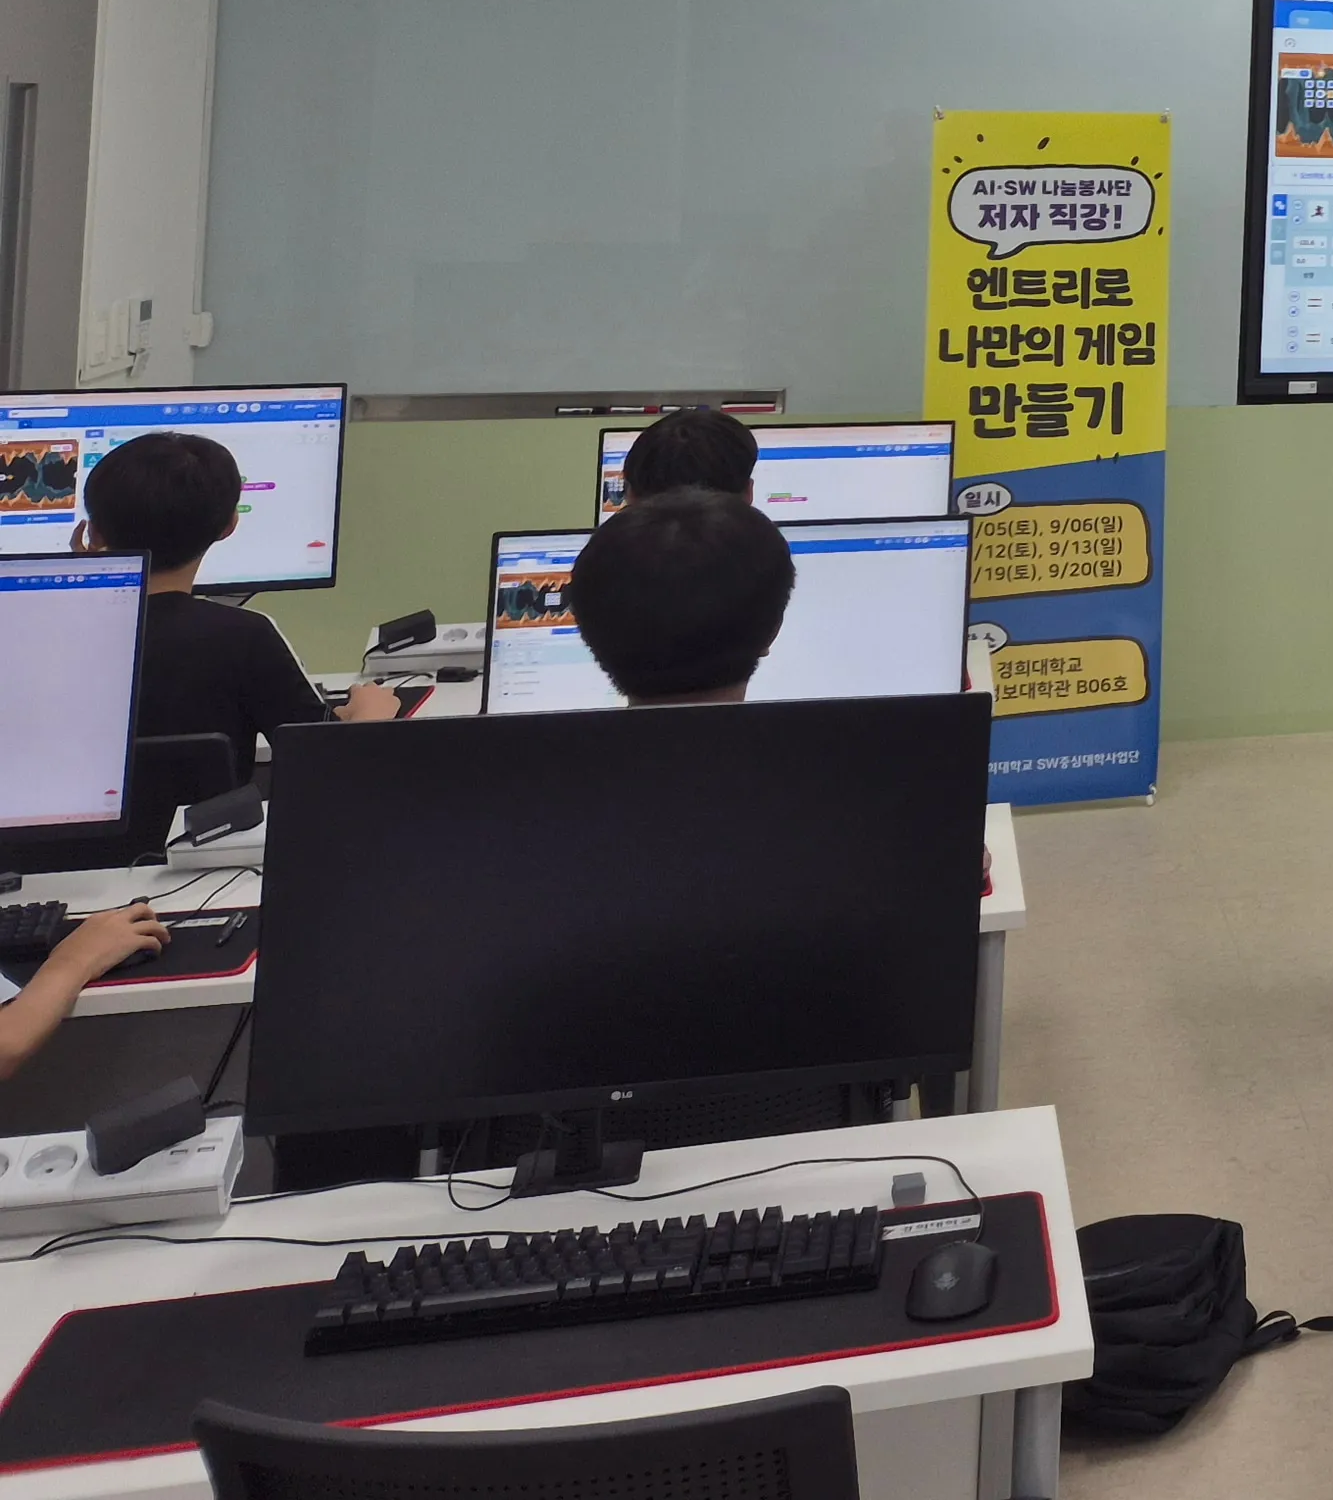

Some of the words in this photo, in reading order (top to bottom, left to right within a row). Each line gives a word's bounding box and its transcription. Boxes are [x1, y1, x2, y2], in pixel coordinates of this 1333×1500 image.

[1041, 179, 1133, 197] 나눔봉사단
[977, 203, 1041, 231] 저자
[1048, 203, 1123, 232] 직강!
[966, 266, 1134, 311] 엔트리로
[938, 323, 1065, 369] 나만의
[1073, 321, 1157, 367] 게임
[968, 381, 1125, 439] 만들기
[964, 490, 1001, 509] 일시
[974, 519, 1044, 538] /05(토),
[1049, 514, 1123, 536] 9/06(일)
[973, 541, 1044, 562] /12(토),
[1049, 536, 1123, 558] 9/13(일)
[973, 562, 1044, 584] /19(토),
[1048, 558, 1123, 579] 9/20(일)
[997, 656, 1083, 680] 경희대학교
[1076, 674, 1129, 695] B06호
[988, 759, 1033, 776] 희대학교
[1036, 749, 1140, 771] SW중심대학사업단
